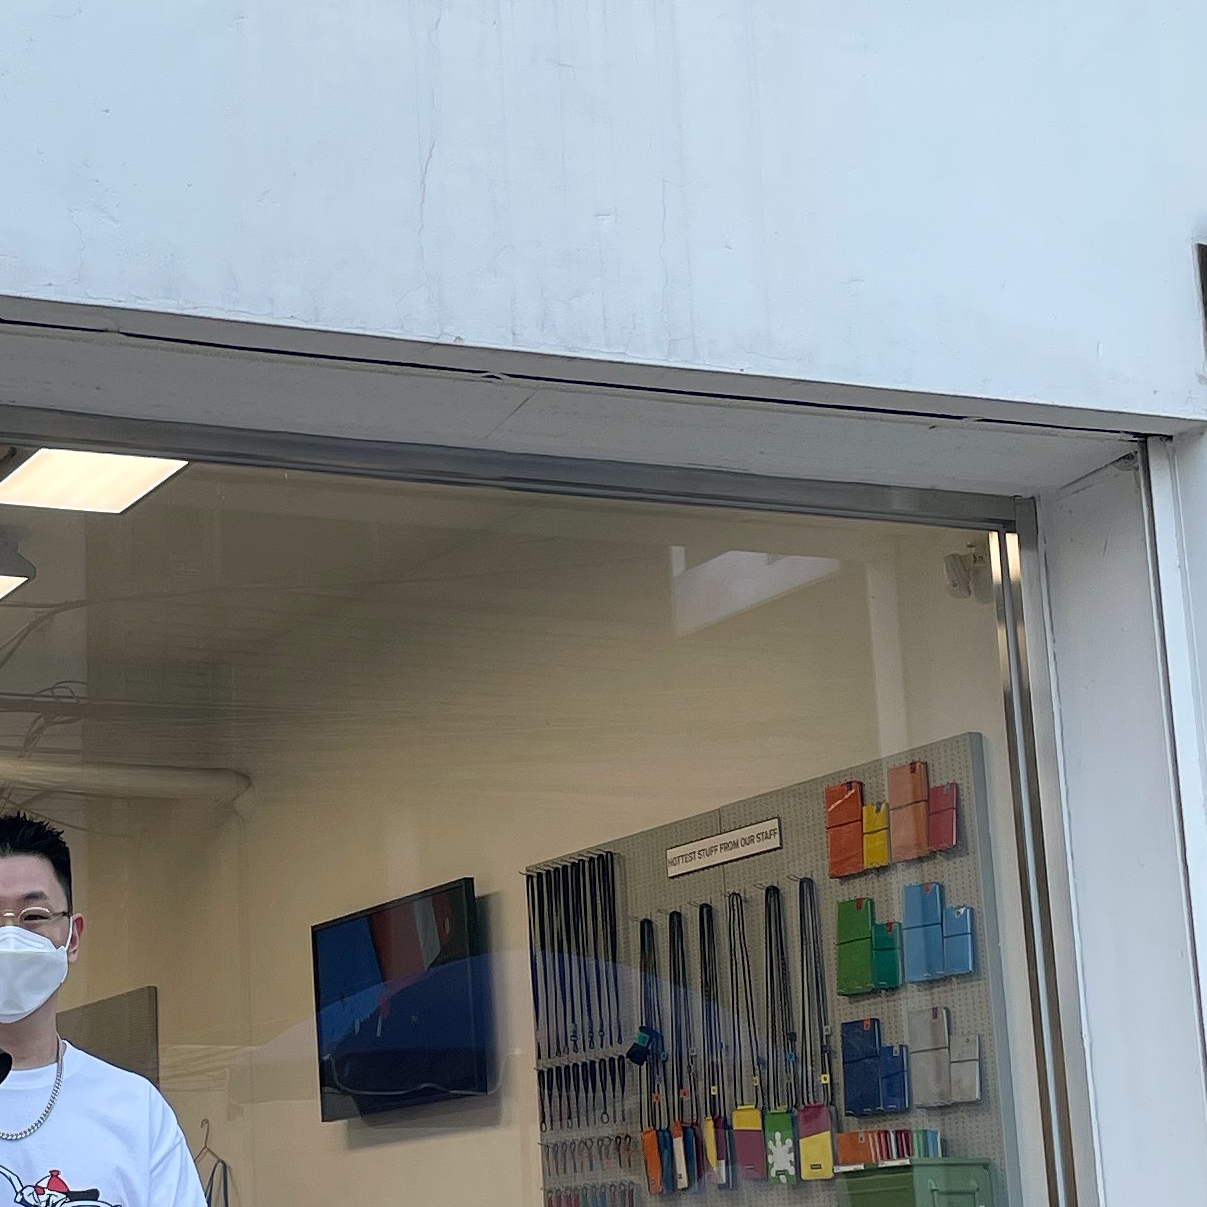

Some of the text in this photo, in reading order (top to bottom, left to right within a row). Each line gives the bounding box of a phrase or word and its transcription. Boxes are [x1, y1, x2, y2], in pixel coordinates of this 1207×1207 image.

[667, 827, 778, 868] HOTTEST STUFF FROM OUR STAFF
